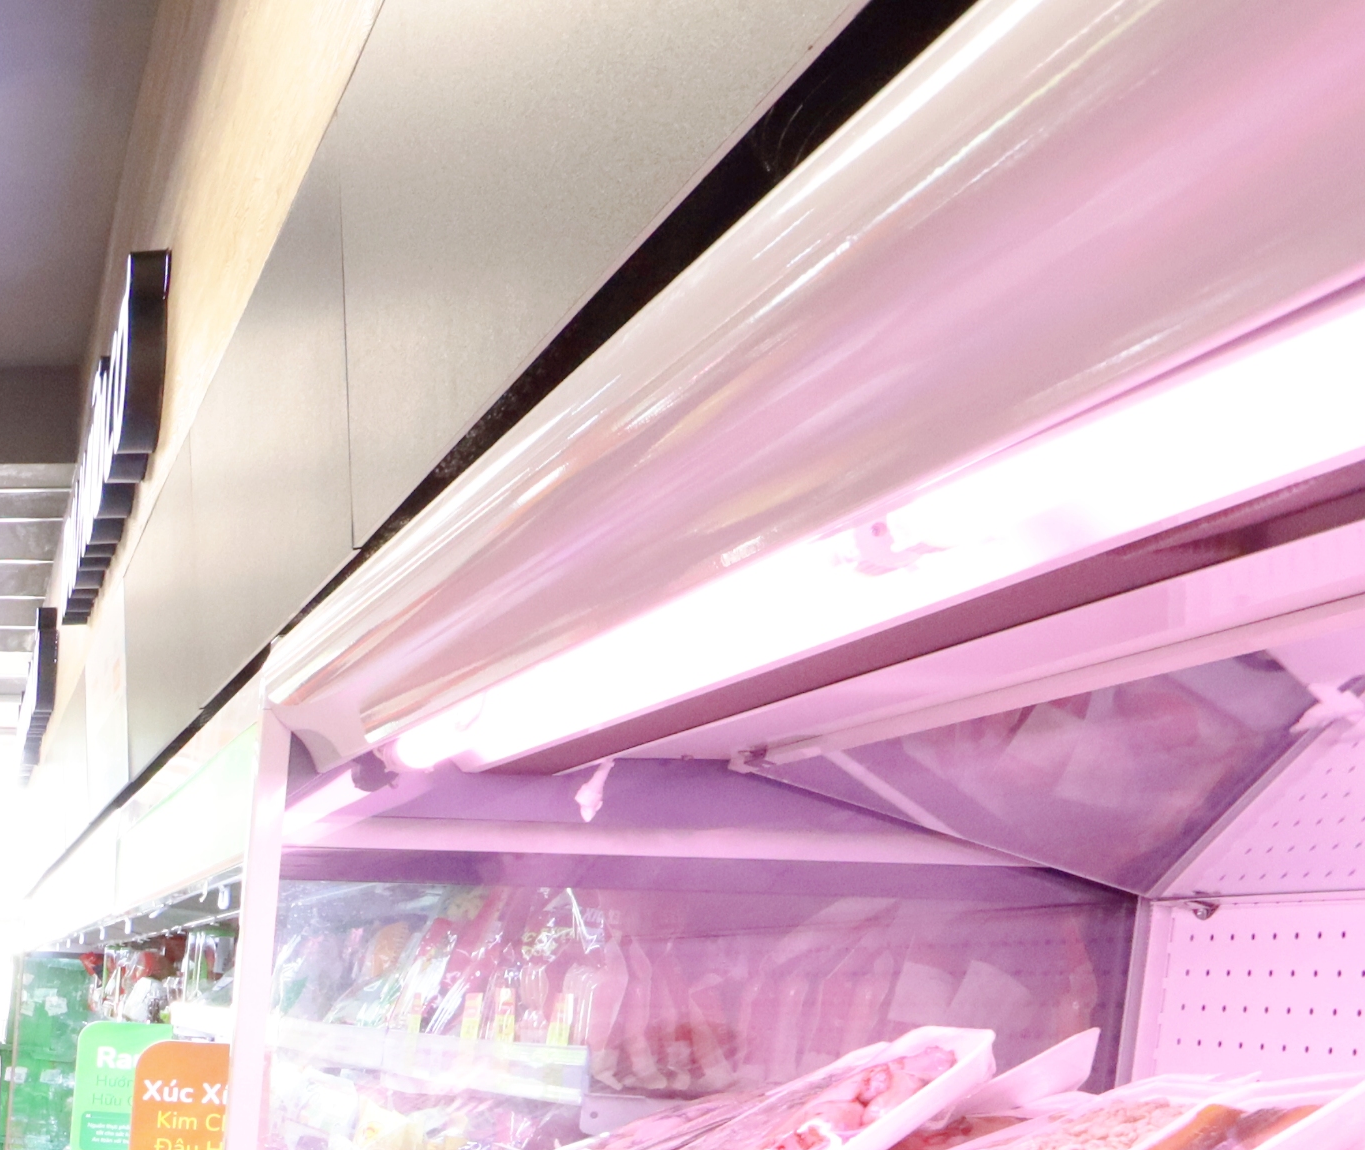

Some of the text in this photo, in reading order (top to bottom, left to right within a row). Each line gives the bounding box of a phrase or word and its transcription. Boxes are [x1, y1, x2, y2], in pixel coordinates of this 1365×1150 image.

[142, 1079, 229, 1105] Xúc Xí
[156, 1110, 198, 1131] Kim
